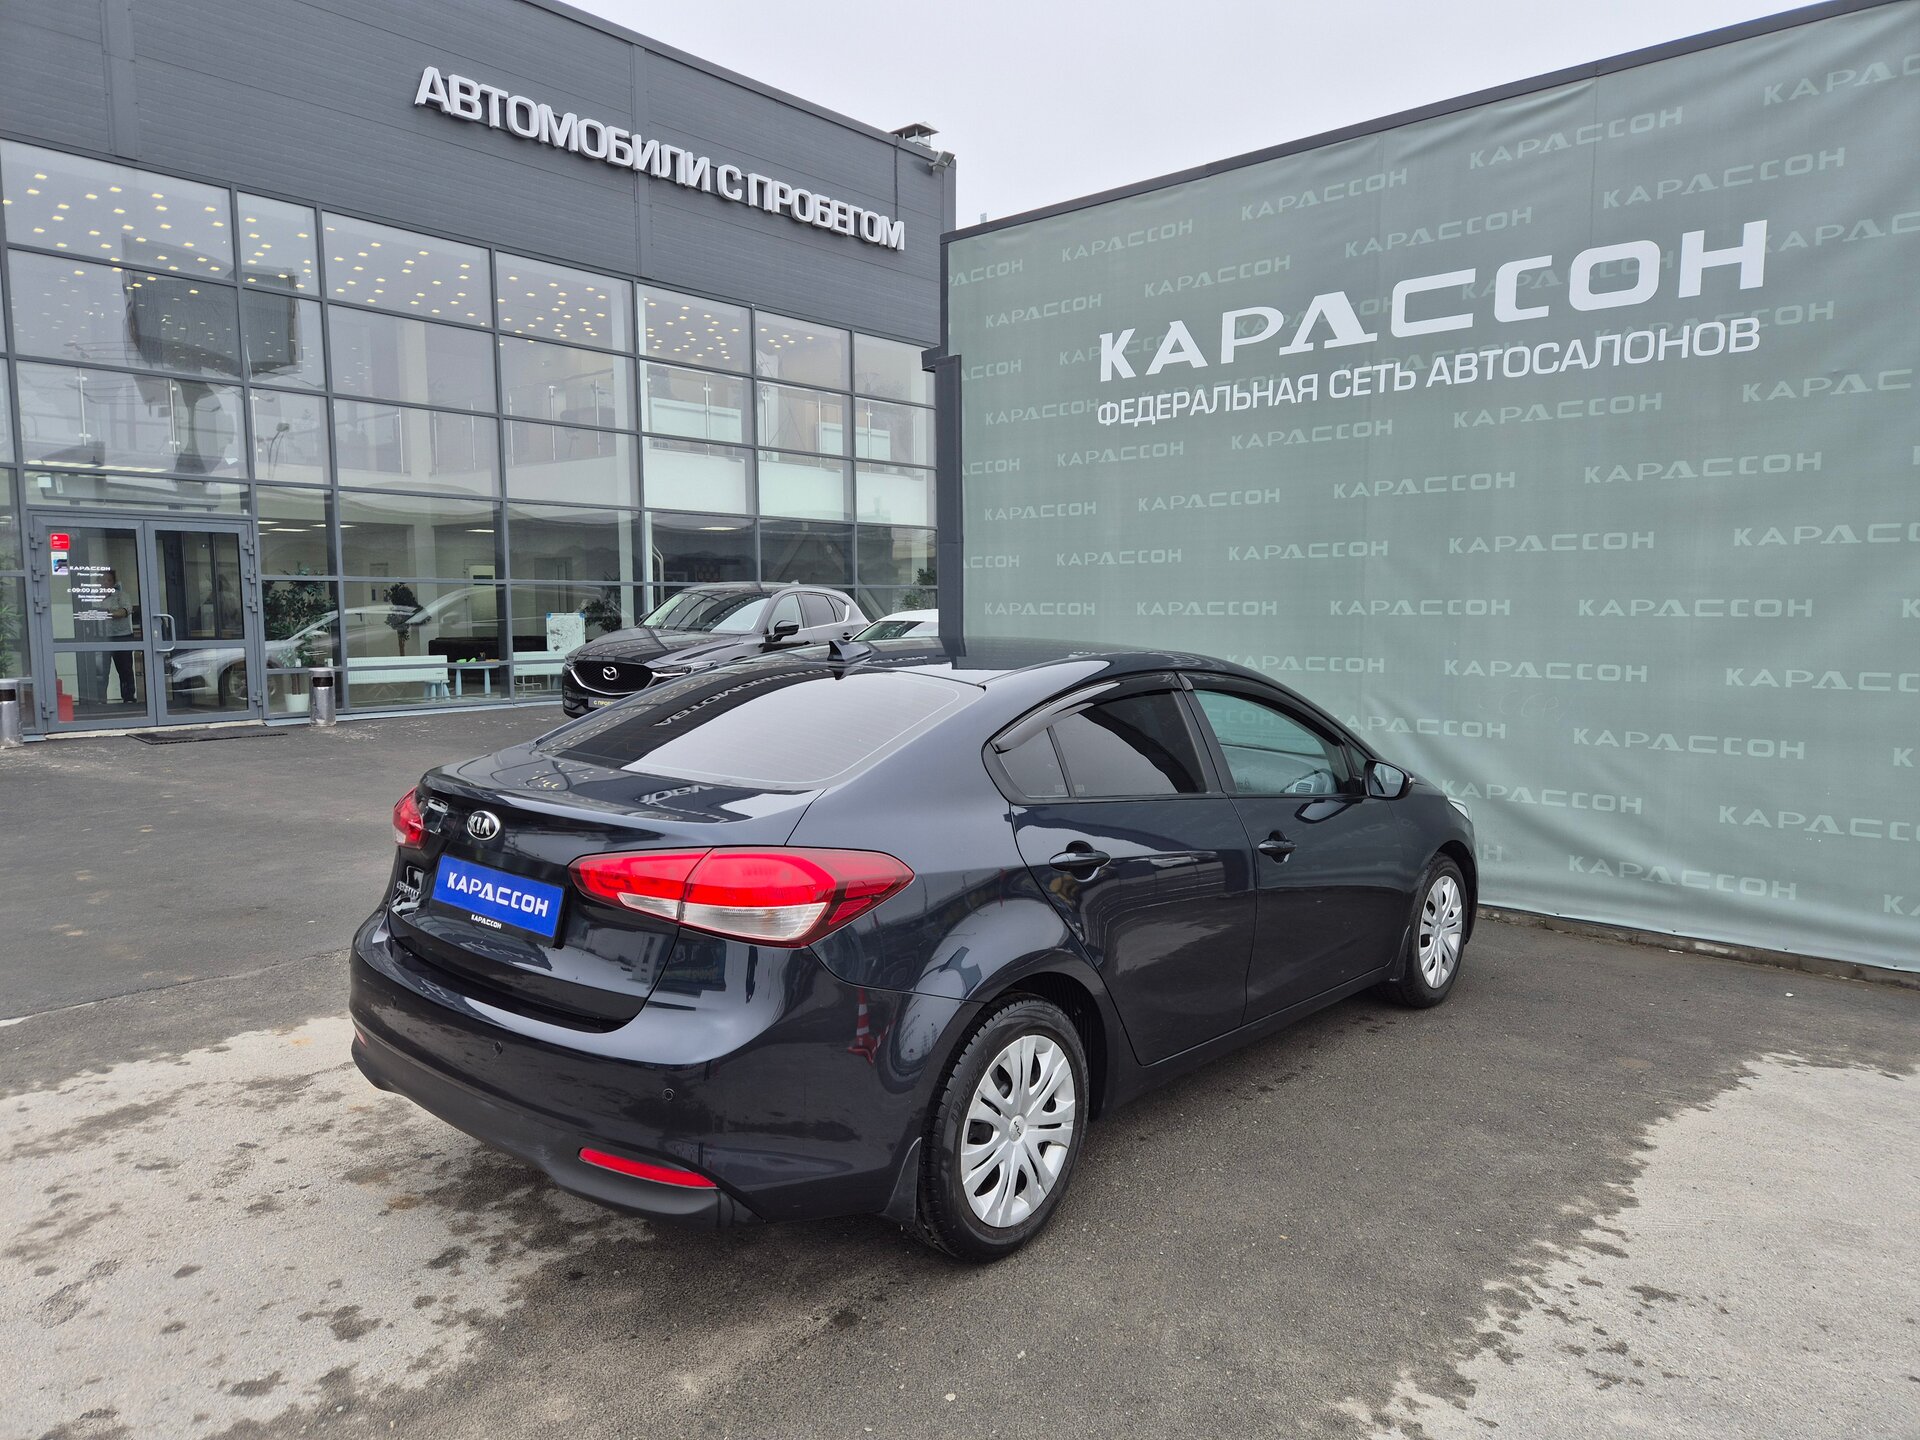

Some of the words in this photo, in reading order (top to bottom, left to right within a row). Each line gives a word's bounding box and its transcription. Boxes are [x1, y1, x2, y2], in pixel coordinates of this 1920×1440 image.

[1469, 106, 1684, 170] КАРАССОН
[414, 66, 711, 193] АВТОМОБИЛИ
[717, 164, 743, 201] С
[747, 173, 905, 252] ПРОБЕГОМ
[1602, 147, 1846, 210] КАРАССОН
[1242, 168, 1408, 222] КАРАССОН
[1061, 219, 1194, 263] КАРАССОН
[1345, 206, 1533, 259] КАРАССОН
[1144, 255, 1291, 298] КАРАССОН
[985, 293, 1103, 329] КАРАССОН
[1099, 219, 1768, 382] КАРАССОН
[1097, 373, 1318, 427] ФЕДЕРАЛЬНАЯ
[1328, 362, 1417, 399] СЕТЬ
[1426, 317, 1760, 388] АВТОСАЛОНОВ
[1454, 392, 1663, 429] КАРАССОН
[1232, 419, 1394, 451] КАРАССОН
[1057, 441, 1185, 467] КАРАССОН
[1584, 452, 1823, 484] КАРАССОН
[1138, 488, 1281, 512] КАРАССОН
[1334, 472, 1516, 500] КАРАССОН
[985, 501, 1097, 521] КАРАССОН
[1057, 549, 1183, 567] КАРАССОН
[1229, 540, 1389, 562] КАРАССОН
[1449, 531, 1655, 555] КАРАССОН
[985, 602, 1096, 616] КАРАССОН
[1137, 600, 1278, 616] КАРАССОН
[1330, 599, 1511, 616] КАРАССОН
[1579, 598, 1813, 618] КАРАССОН
[1444, 659, 1648, 683] КАРАССОН
[1573, 728, 1806, 761] КАРАССОН
[467, 815, 491, 836] KIA
[446, 871, 550, 918] КАРАССОН
[470, 914, 503, 930] КАРАССОН
